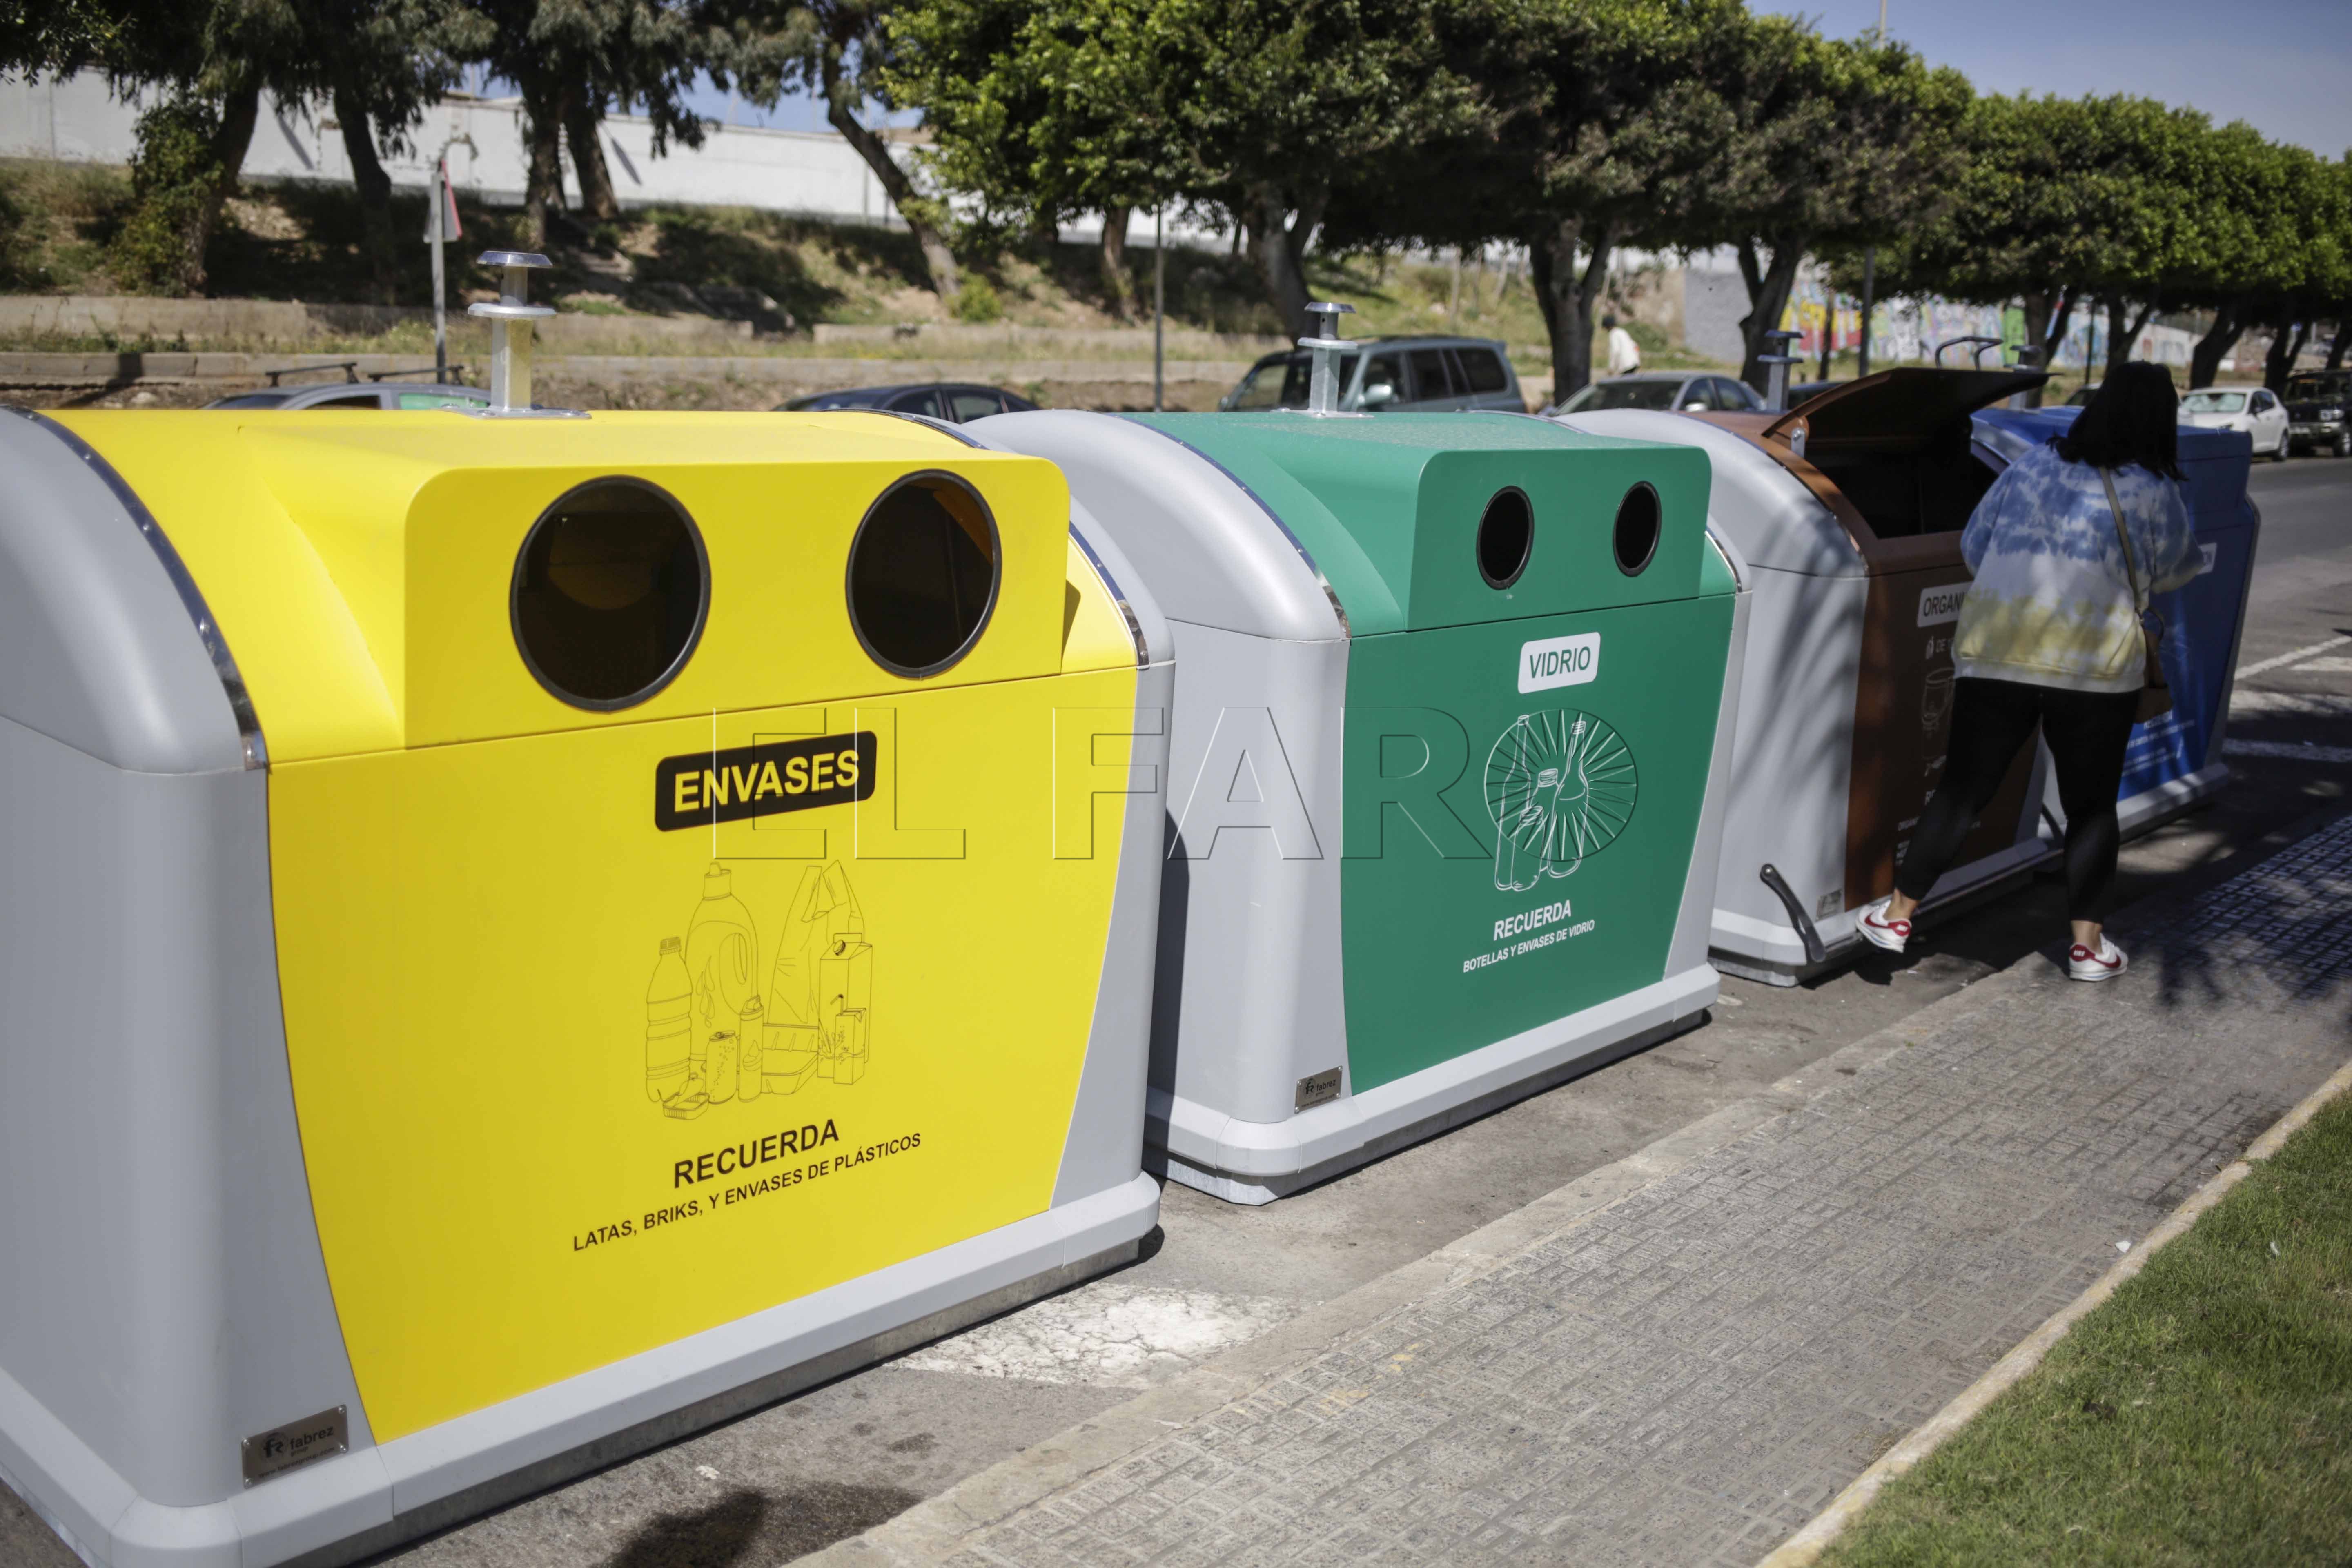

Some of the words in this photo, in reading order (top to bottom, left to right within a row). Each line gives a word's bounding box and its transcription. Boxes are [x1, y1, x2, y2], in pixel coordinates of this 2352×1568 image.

[1529, 646, 1591, 679] VIDRIO
[674, 749, 859, 813] ENVASES
[1463, 947, 1509, 973] BOTELLAS
[1510, 944, 1517, 957] Y
[1517, 932, 1555, 955] ENVASES
[1556, 928, 1567, 942] DE
[1569, 920, 1595, 938] VIDRIO
[1493, 899, 1572, 941] RECUERDA
[674, 1119, 840, 1188] RECUERDA
[573, 1219, 637, 1251] LATAS,
[644, 1200, 703, 1230] BRIKS,
[709, 1193, 720, 1209] Y
[725, 1169, 803, 1205] ENVASES
[808, 1160, 829, 1180] DE
[835, 1132, 922, 1172] PLÁSTICOS
[290, 1426, 334, 1450] fabrez
